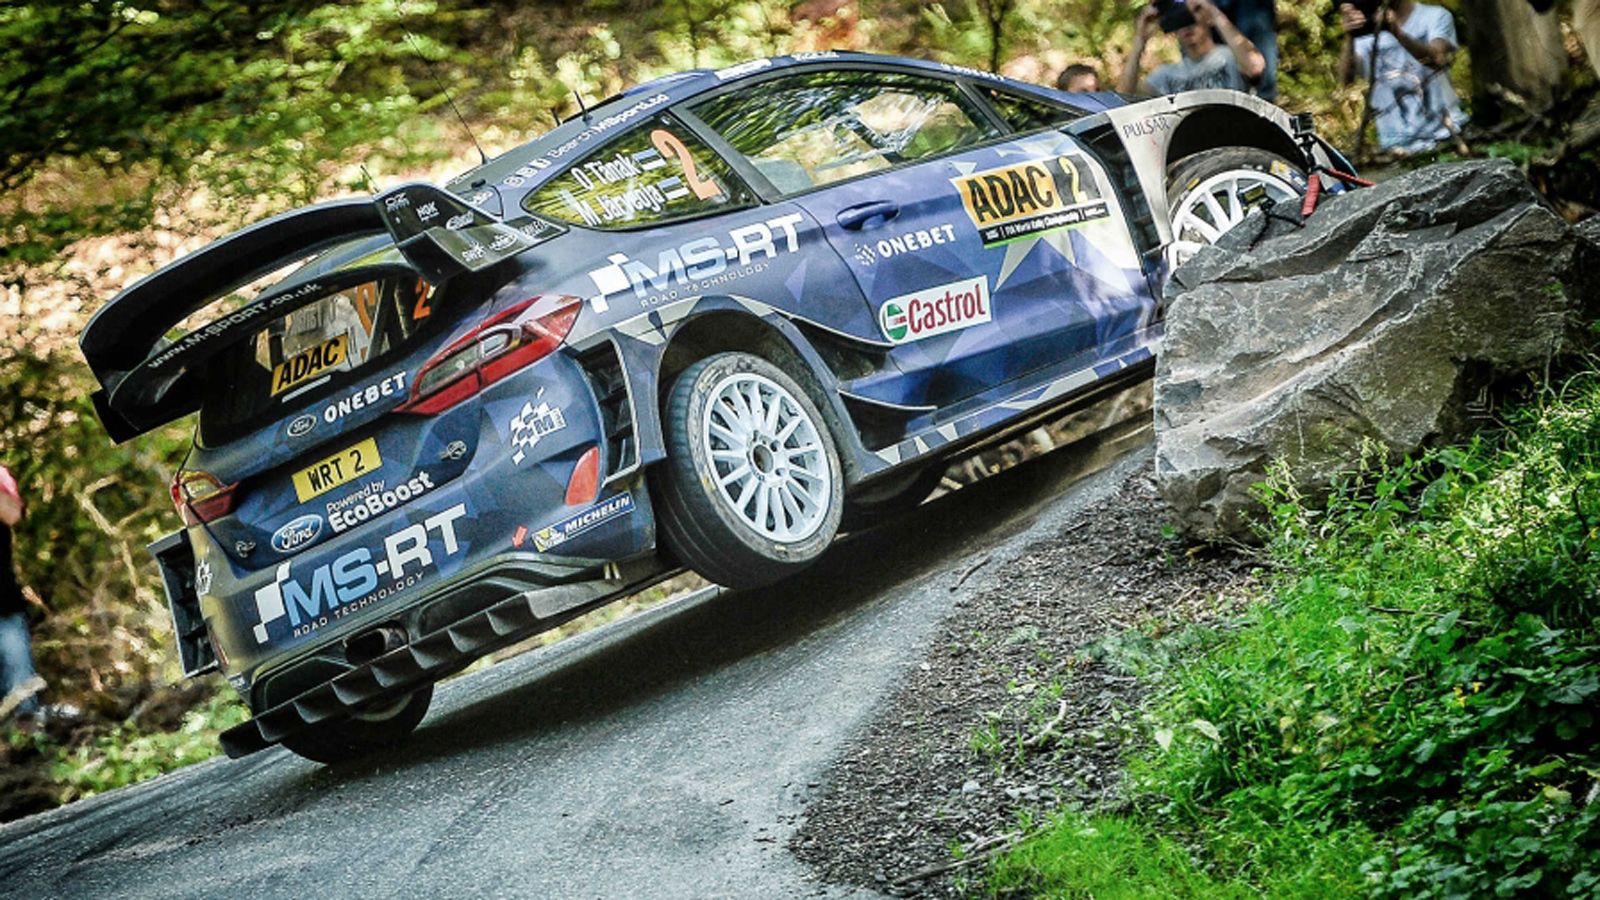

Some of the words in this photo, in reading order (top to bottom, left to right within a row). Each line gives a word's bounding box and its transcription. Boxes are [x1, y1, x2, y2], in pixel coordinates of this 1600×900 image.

[1122, 117, 1171, 138] PULSAR
[650, 129, 722, 201] 2
[967, 165, 1052, 222] ADAC
[1062, 157, 1086, 203] 2
[623, 213, 803, 298] MS-RT
[878, 224, 956, 258] ONEBET
[907, 284, 986, 334] Castrol
[277, 339, 340, 389] ADAC
[324, 371, 407, 423] ONEBET
[307, 457, 344, 492] WRT
[349, 449, 366, 474] 2
[326, 484, 371, 515] Powered
[372, 479, 386, 493] by
[328, 470, 435, 533] EcoBoost
[564, 495, 631, 533] MICHELIN
[281, 522, 315, 549] Ford
[281, 502, 467, 628] MS-RT
[292, 616, 328, 639] ROAD
[334, 571, 424, 620] TECHNOLOGY
